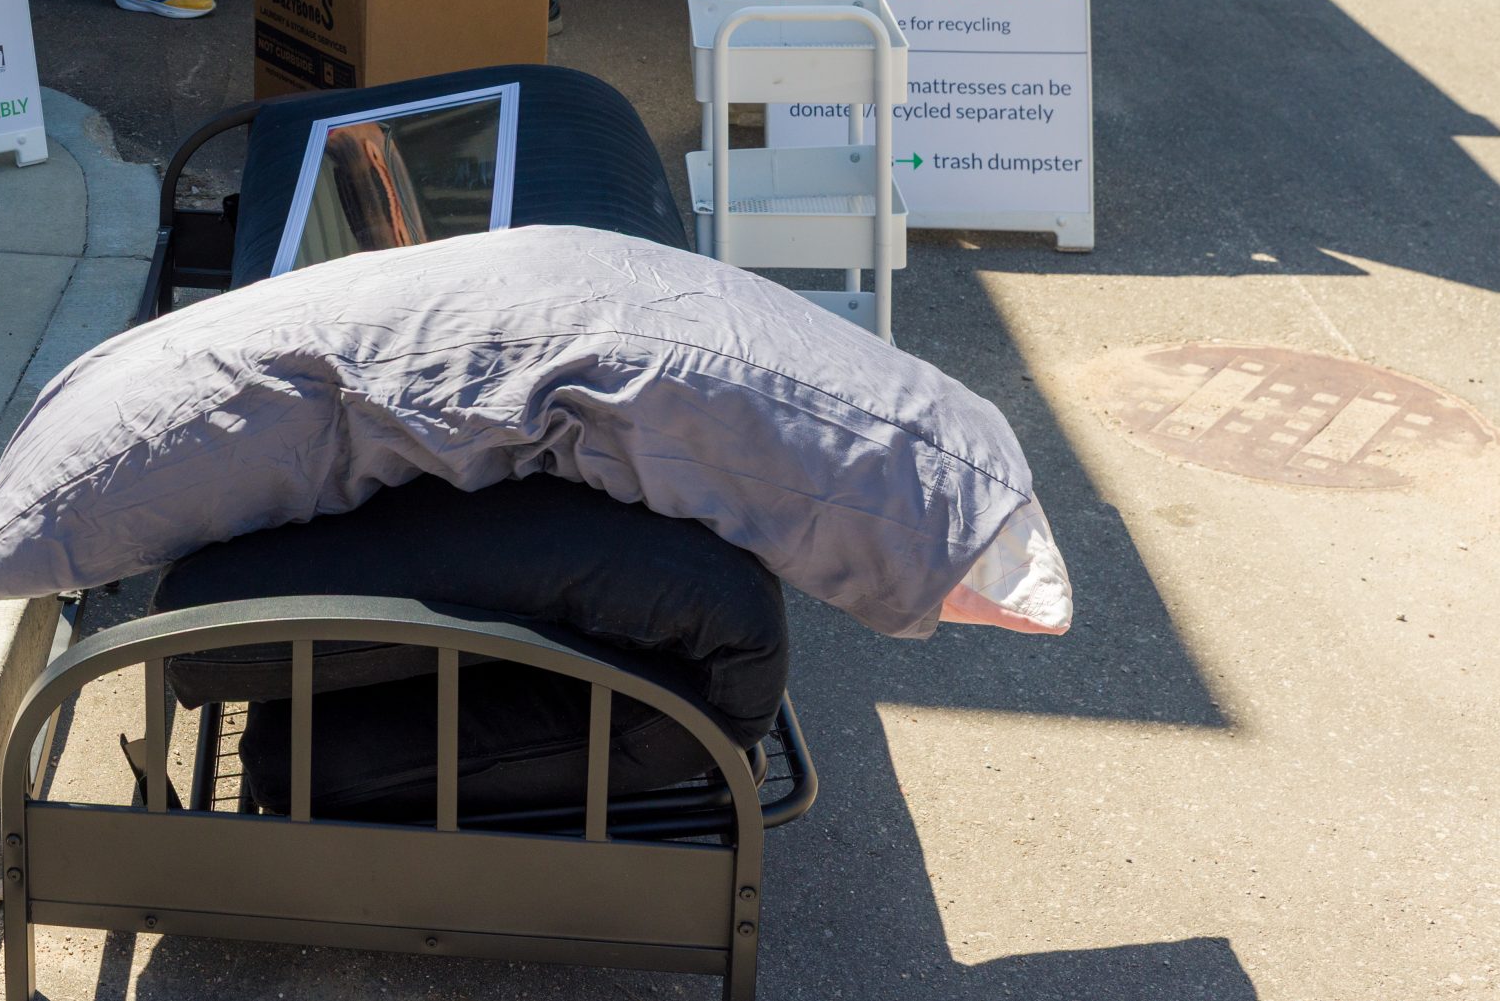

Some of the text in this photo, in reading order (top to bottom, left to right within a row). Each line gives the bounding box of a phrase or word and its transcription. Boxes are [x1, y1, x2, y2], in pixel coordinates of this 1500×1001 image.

[911, 17, 935, 31] for
[938, 17, 1011, 34] recycling
[907, 79, 1072, 96] mattresses can be
[956, 104, 1054, 123] separately
[933, 153, 1083, 174] trash dumpster
